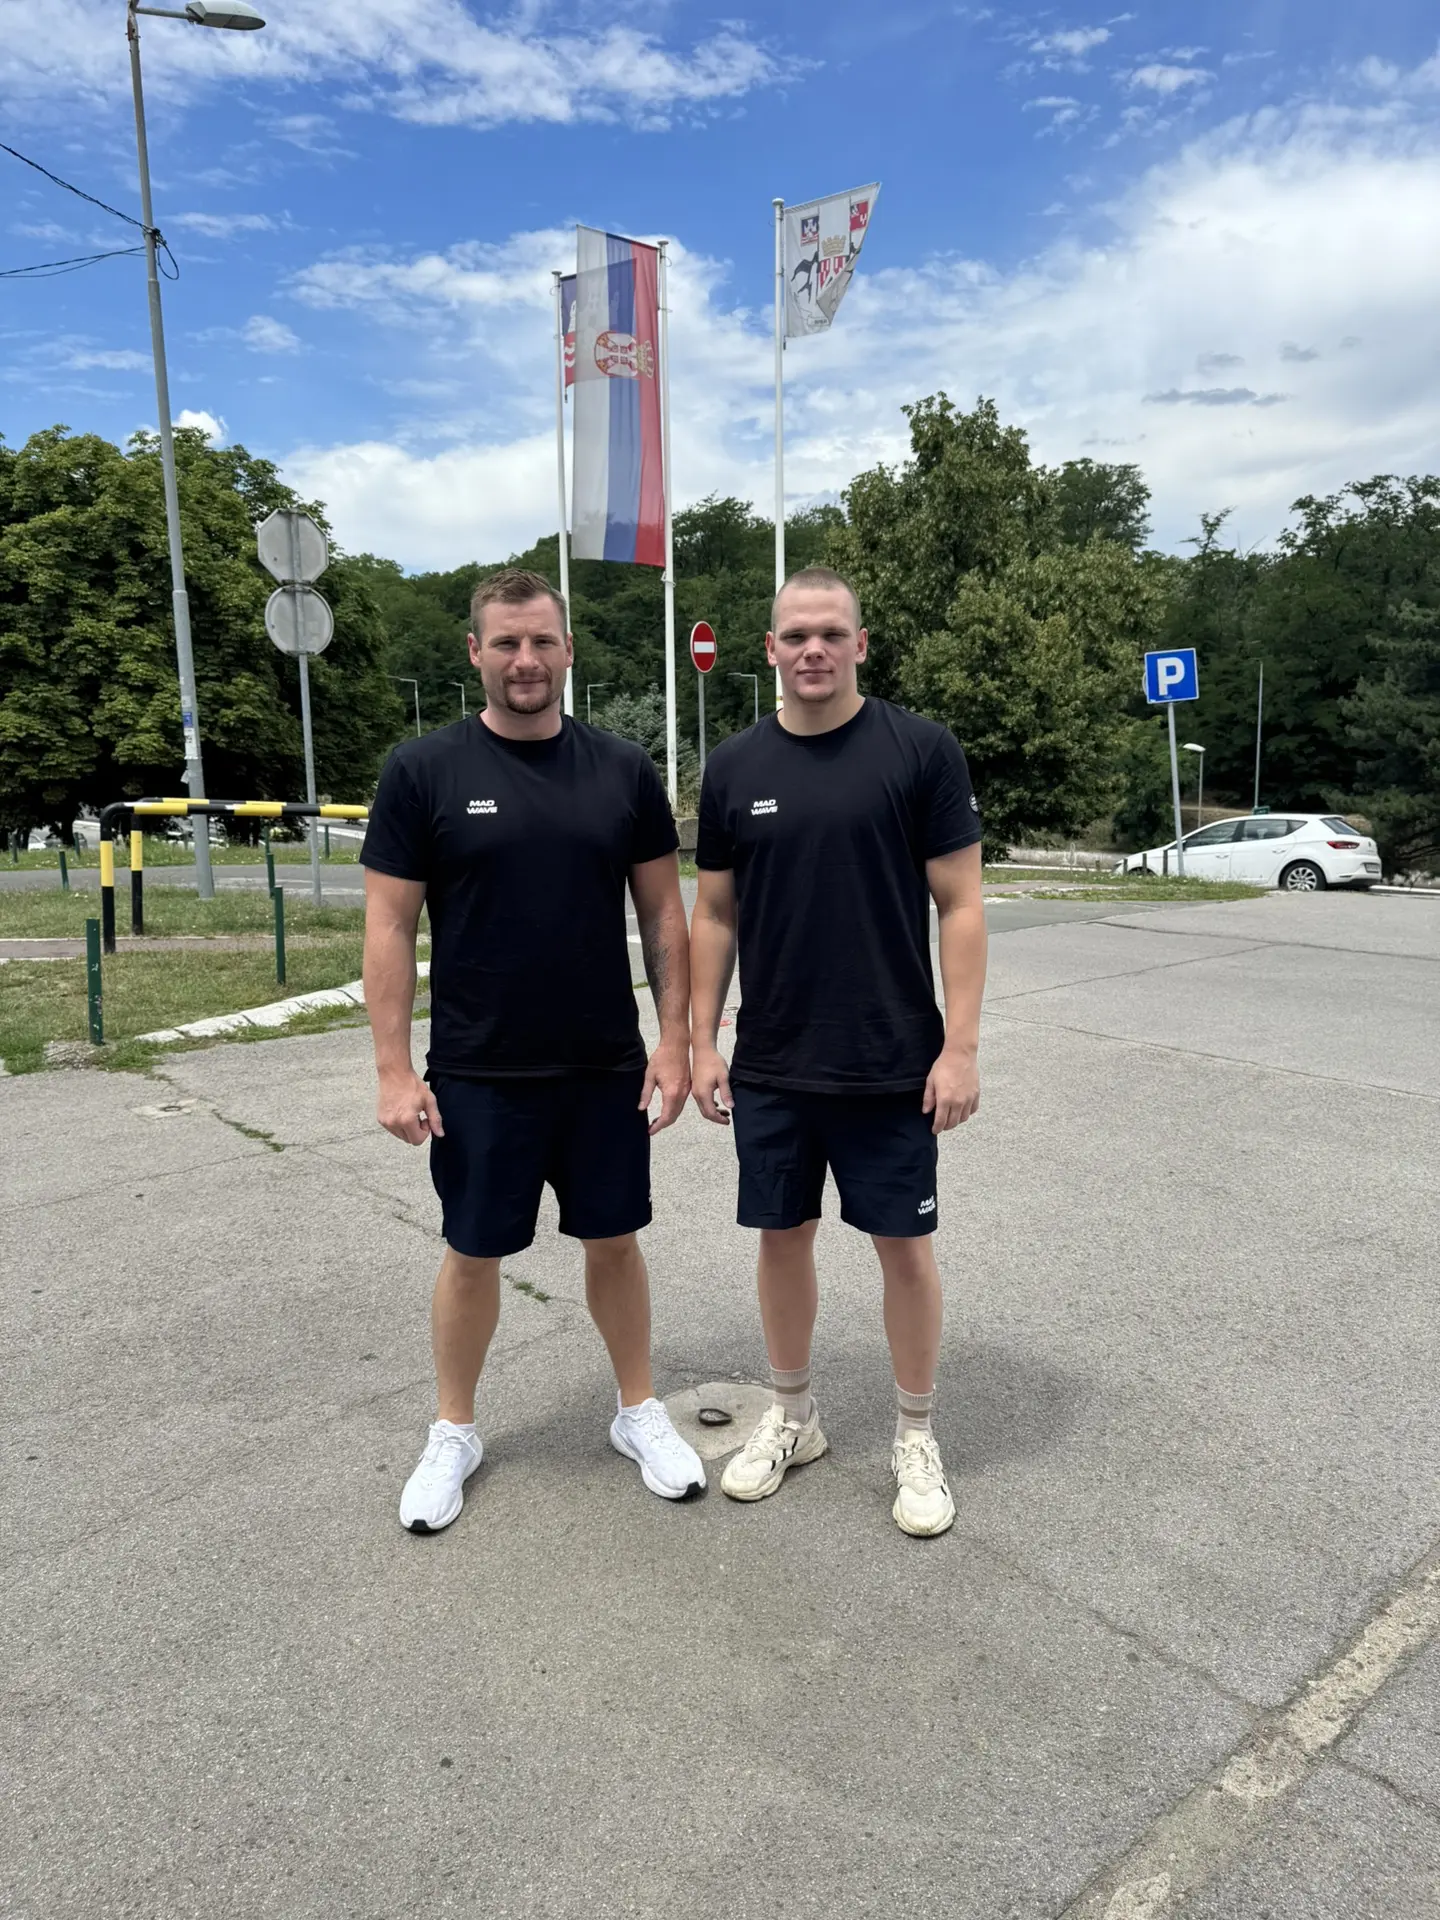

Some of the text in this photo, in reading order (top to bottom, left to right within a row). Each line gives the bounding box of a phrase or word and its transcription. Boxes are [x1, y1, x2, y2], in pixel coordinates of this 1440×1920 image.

[1157, 657, 1185, 696] P
[753, 799, 776, 808] MAD
[466, 806, 498, 814] WAVE
[750, 806, 778, 816] WAVE
